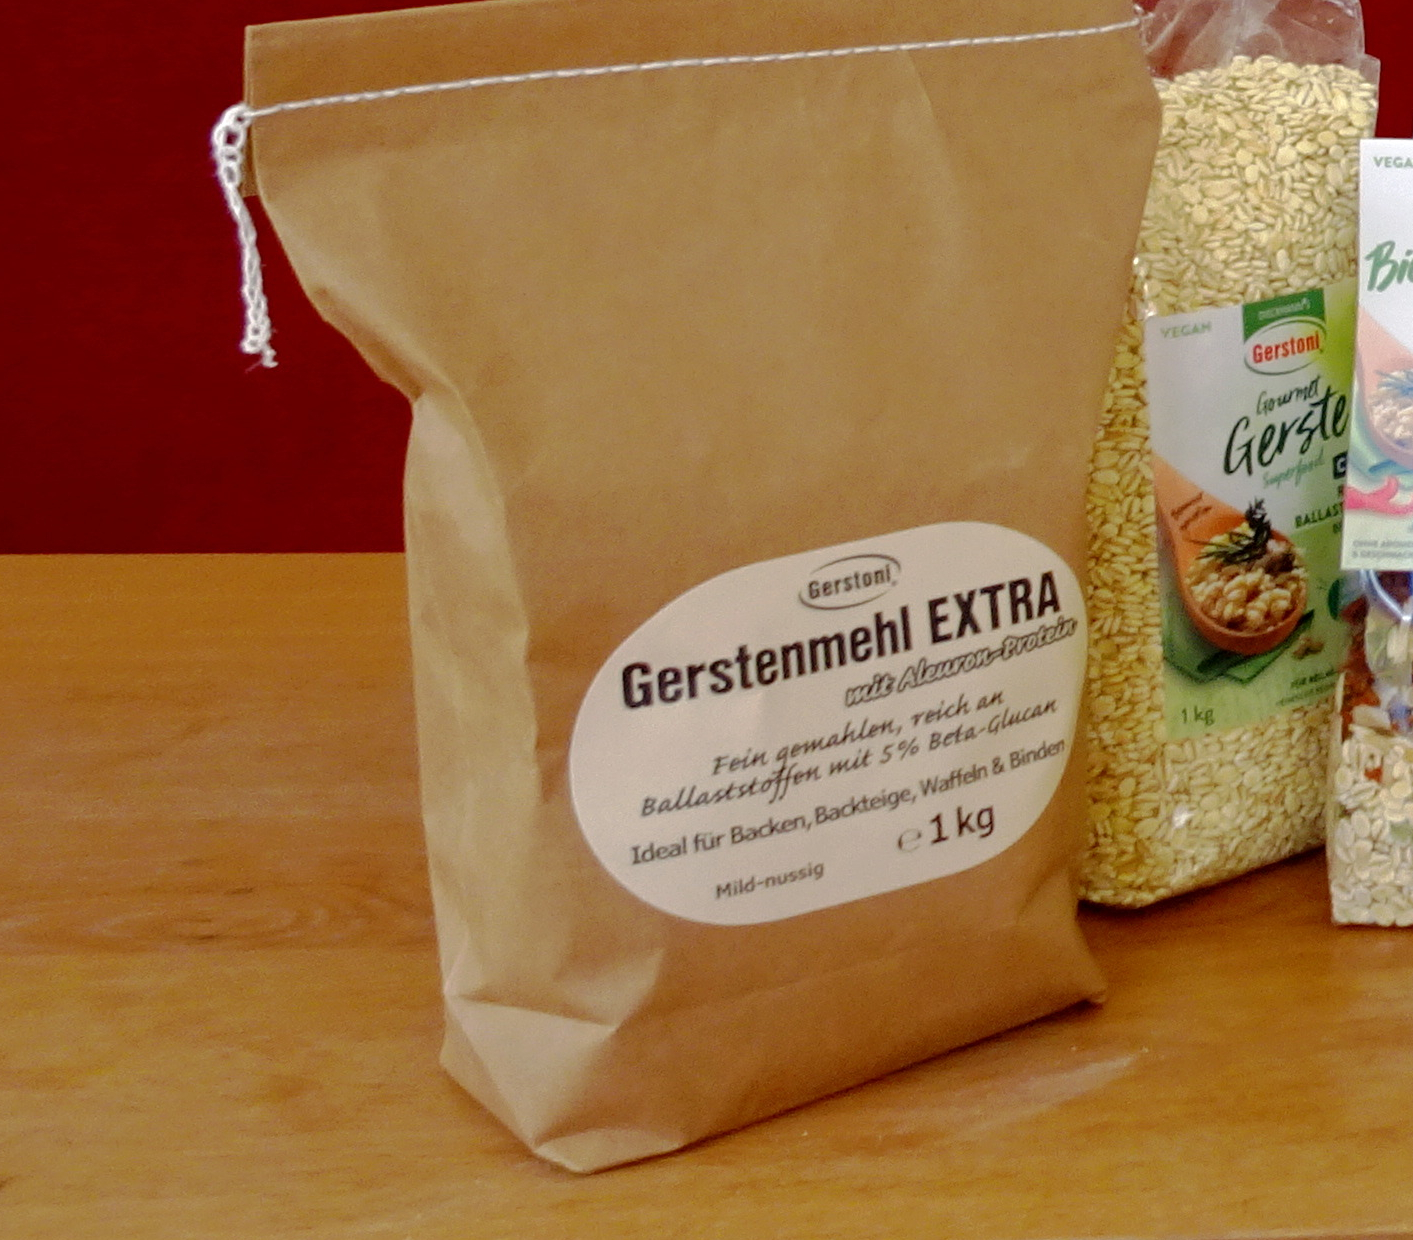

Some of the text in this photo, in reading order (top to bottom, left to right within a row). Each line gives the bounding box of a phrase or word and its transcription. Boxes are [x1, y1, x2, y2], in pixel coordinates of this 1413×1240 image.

[1160, 321, 1212, 339] VEGAN
[1252, 330, 1320, 364] Gerstoni
[1256, 375, 1320, 415] Gourmet
[1224, 386, 1350, 476] Gerste
[807, 564, 893, 600] Gerstoni
[621, 571, 1061, 710] Gerstenmehl EXTRA
[844, 616, 1079, 708] mit Aleuron-Protein
[712, 689, 1005, 778] Fein gemahlen, reich an
[1181, 705, 1215, 726] 1 kg
[640, 763, 822, 818] Ballaststoffen
[829, 750, 872, 780] mit
[928, 699, 1057, 752] Beta-Glucan
[630, 737, 1066, 866] Ideal für Backen, Backteige, Waffeln & Binden
[930, 804, 995, 845] 1 kg
[715, 862, 825, 900] Mild-nussig
